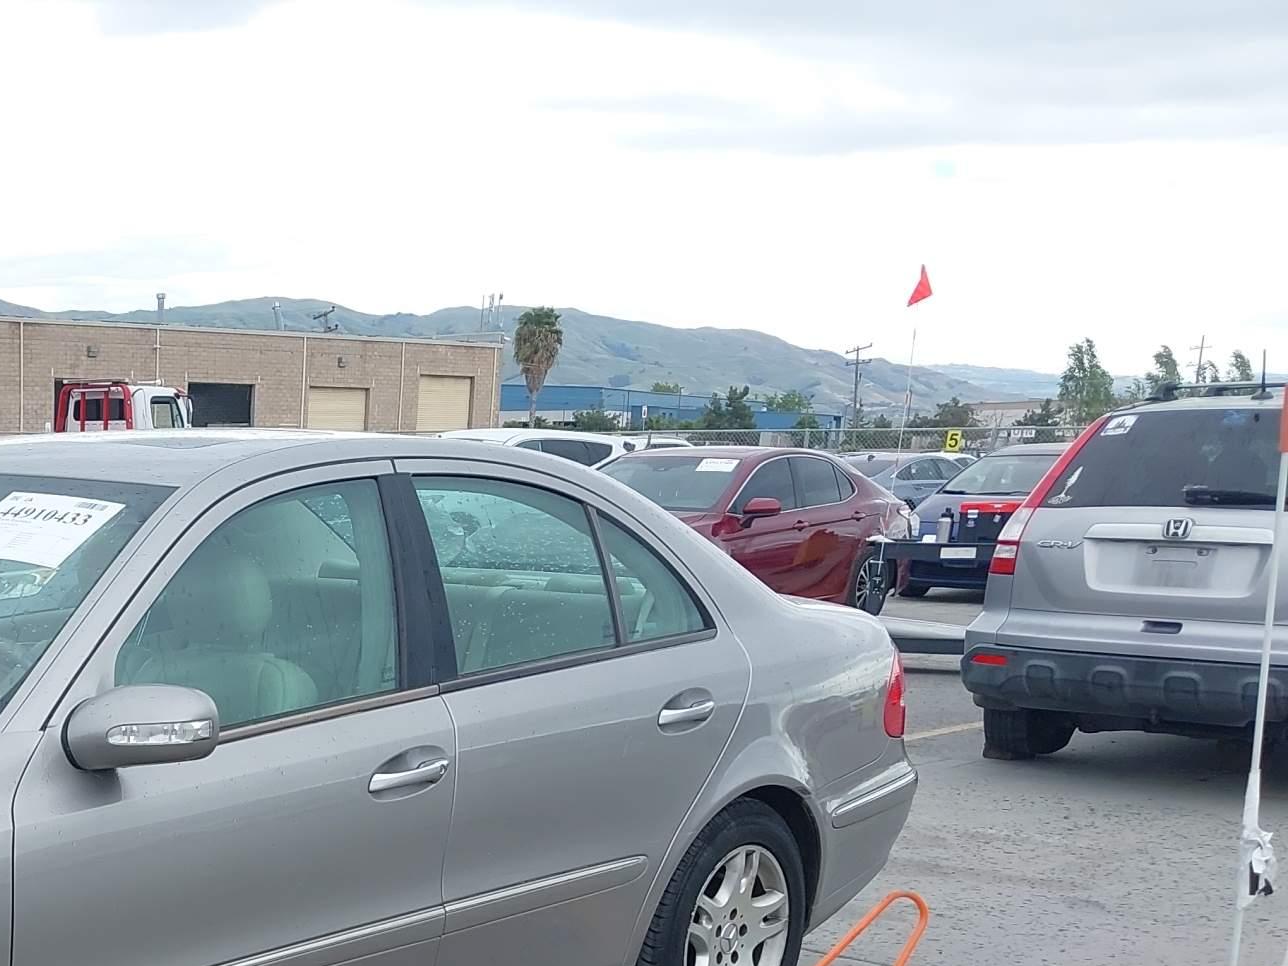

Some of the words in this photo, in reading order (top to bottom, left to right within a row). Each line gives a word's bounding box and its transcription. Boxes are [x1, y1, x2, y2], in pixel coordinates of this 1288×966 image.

[948, 432, 960, 449] 5
[0, 504, 93, 526] 44910433
[1037, 539, 1084, 550] CR-V
